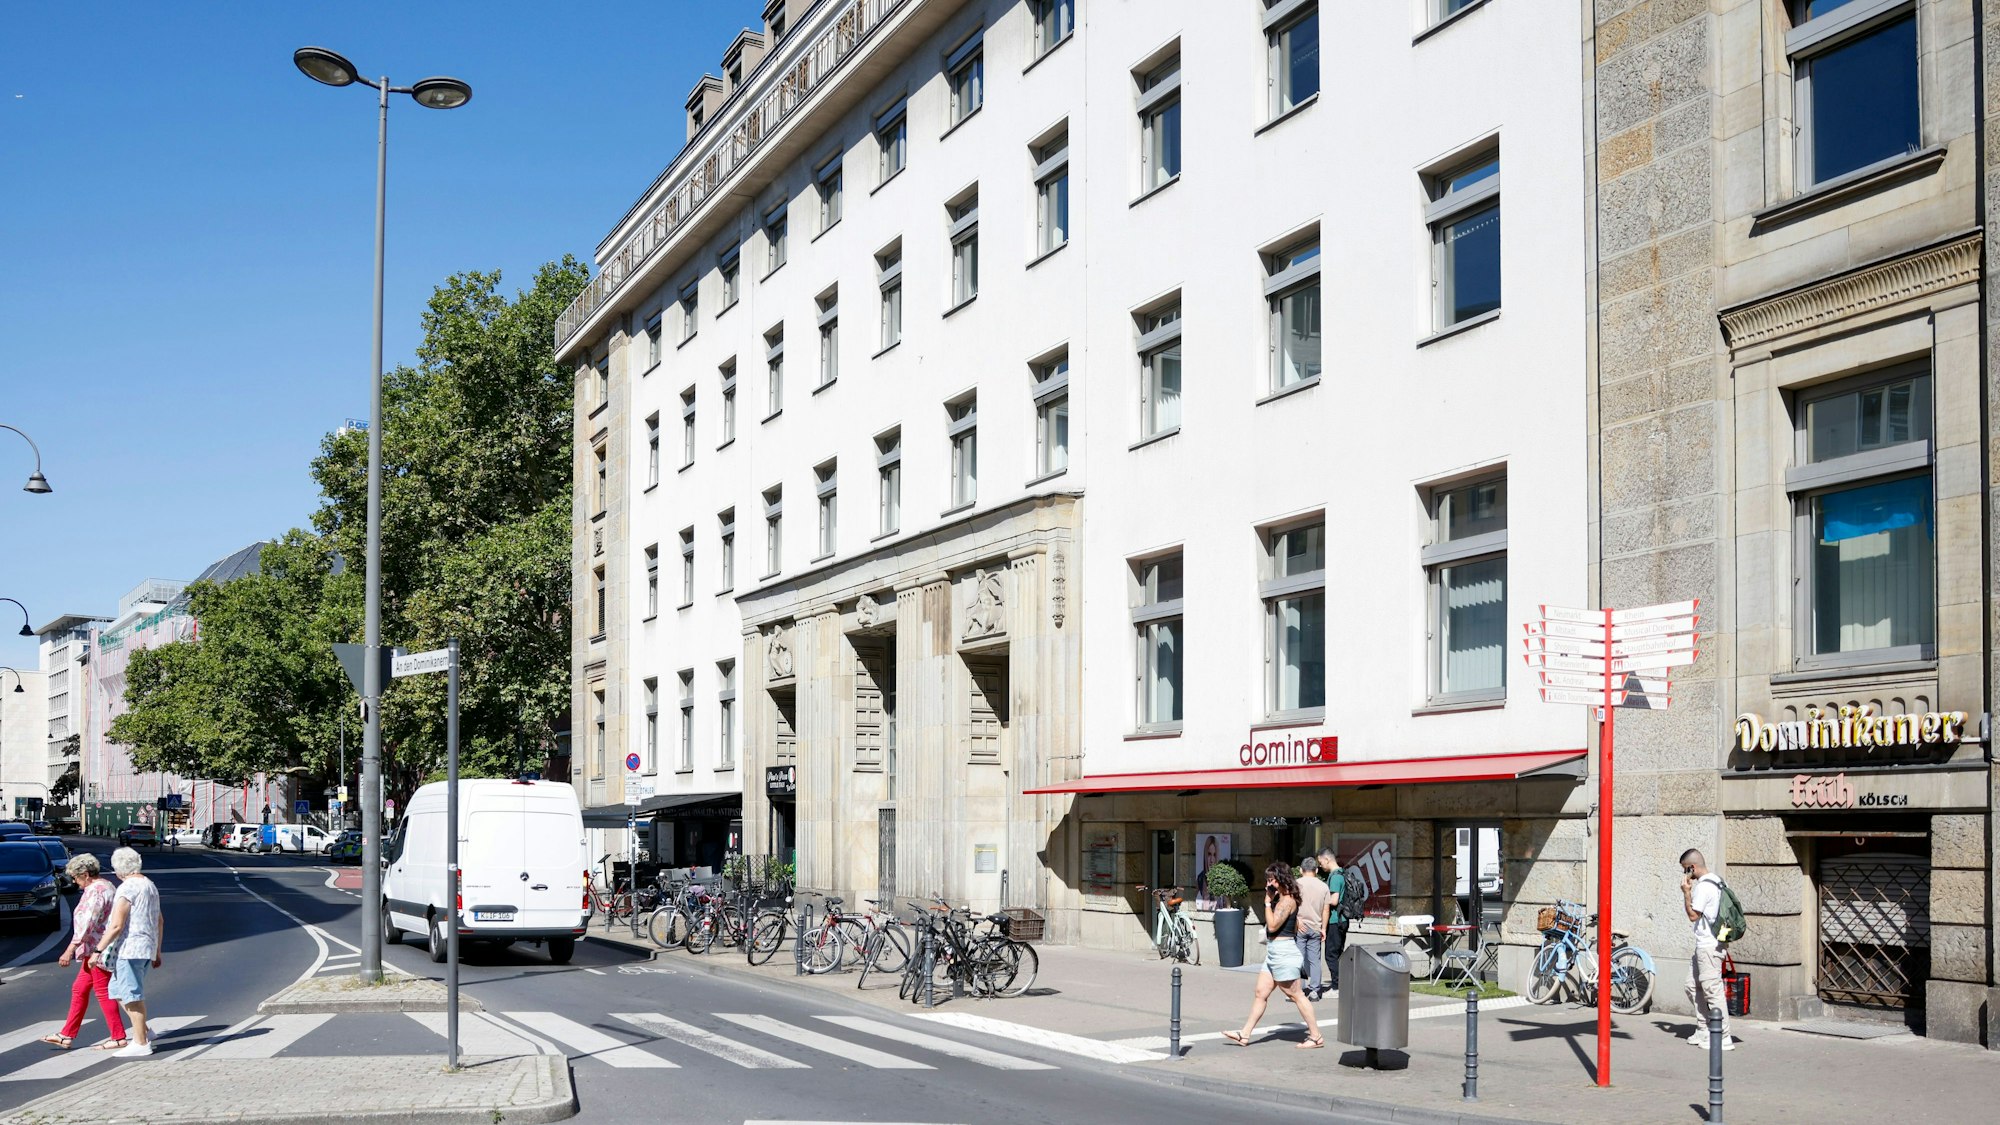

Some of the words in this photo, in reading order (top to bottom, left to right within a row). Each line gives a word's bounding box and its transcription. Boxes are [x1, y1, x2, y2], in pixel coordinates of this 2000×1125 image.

[348, 421, 370, 430] Pos
[1554, 609, 1581, 620] Neumarkt
[1624, 611, 1644, 621] Rhein
[1555, 626, 1577, 636] Altstadt
[1624, 626, 1650, 636] Musical
[1652, 624, 1676, 633] Dome
[1554, 642, 1580, 653] Shopping
[1624, 640, 1677, 652] Hauptbahnhof
[396, 661, 403, 673] An
[404, 660, 412, 671] den
[1624, 660, 1642, 669] Dom
[1554, 691, 1568, 701] Köln
[1734, 704, 1969, 753] Dominikaner
[1240, 734, 1324, 767] domino
[1789, 772, 1854, 809] Früh
[1859, 792, 1908, 806] KÖLSCH
[718, 807, 742, 817] ANTIPAST
